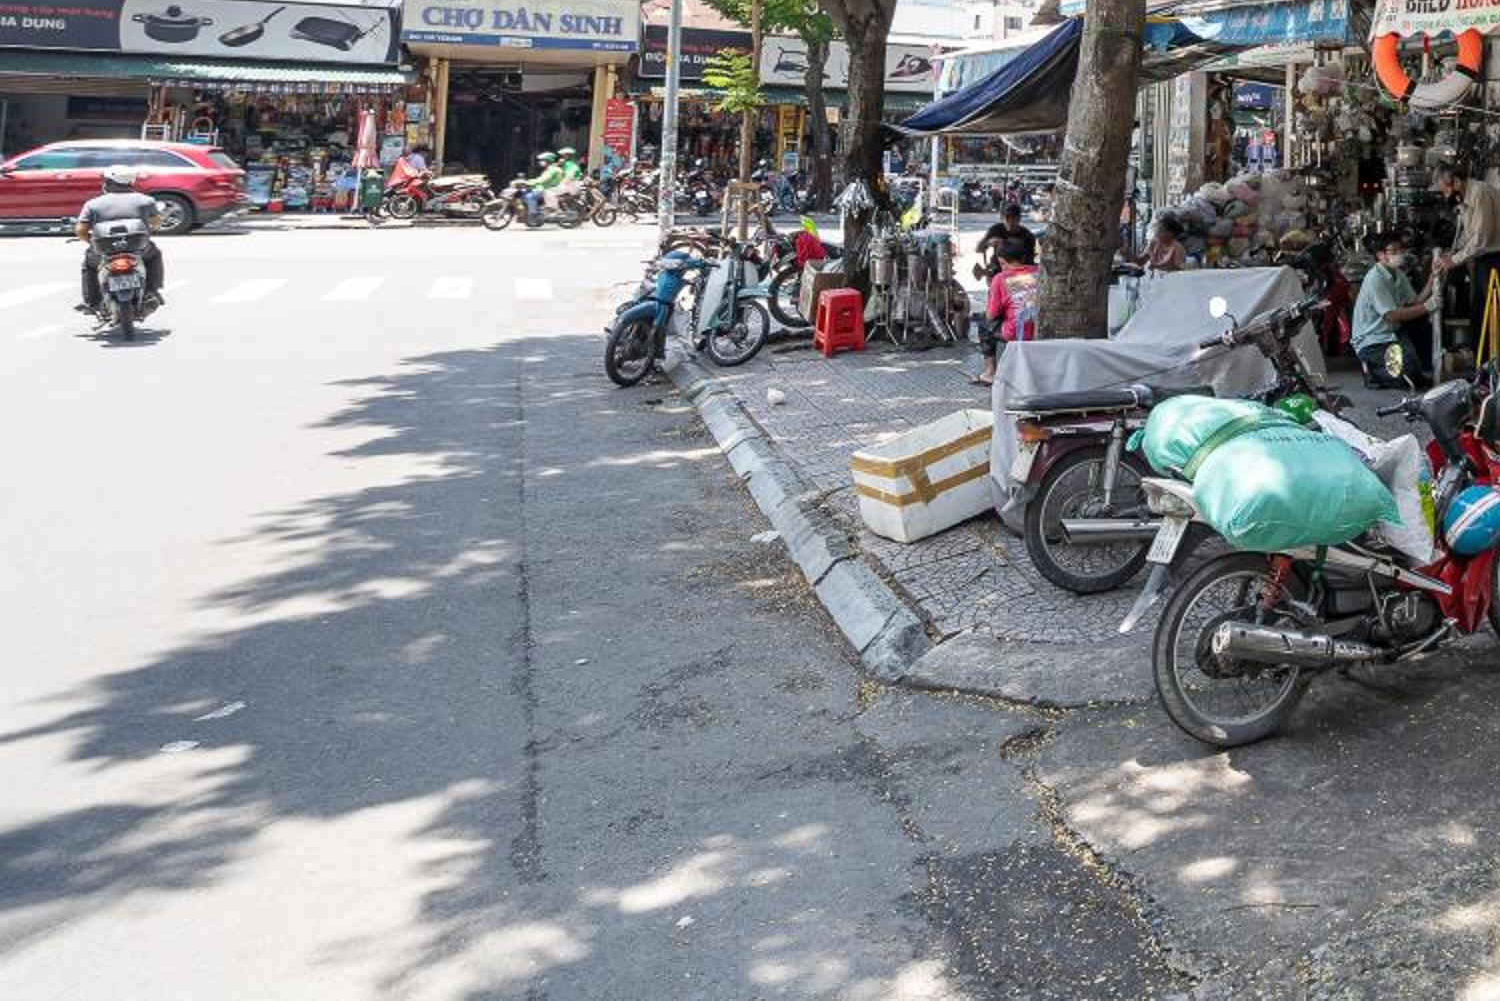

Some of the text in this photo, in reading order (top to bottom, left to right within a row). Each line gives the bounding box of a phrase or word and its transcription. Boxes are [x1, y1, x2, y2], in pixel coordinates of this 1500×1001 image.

[422, 6, 624, 35] CHỢ DÂN SINH
